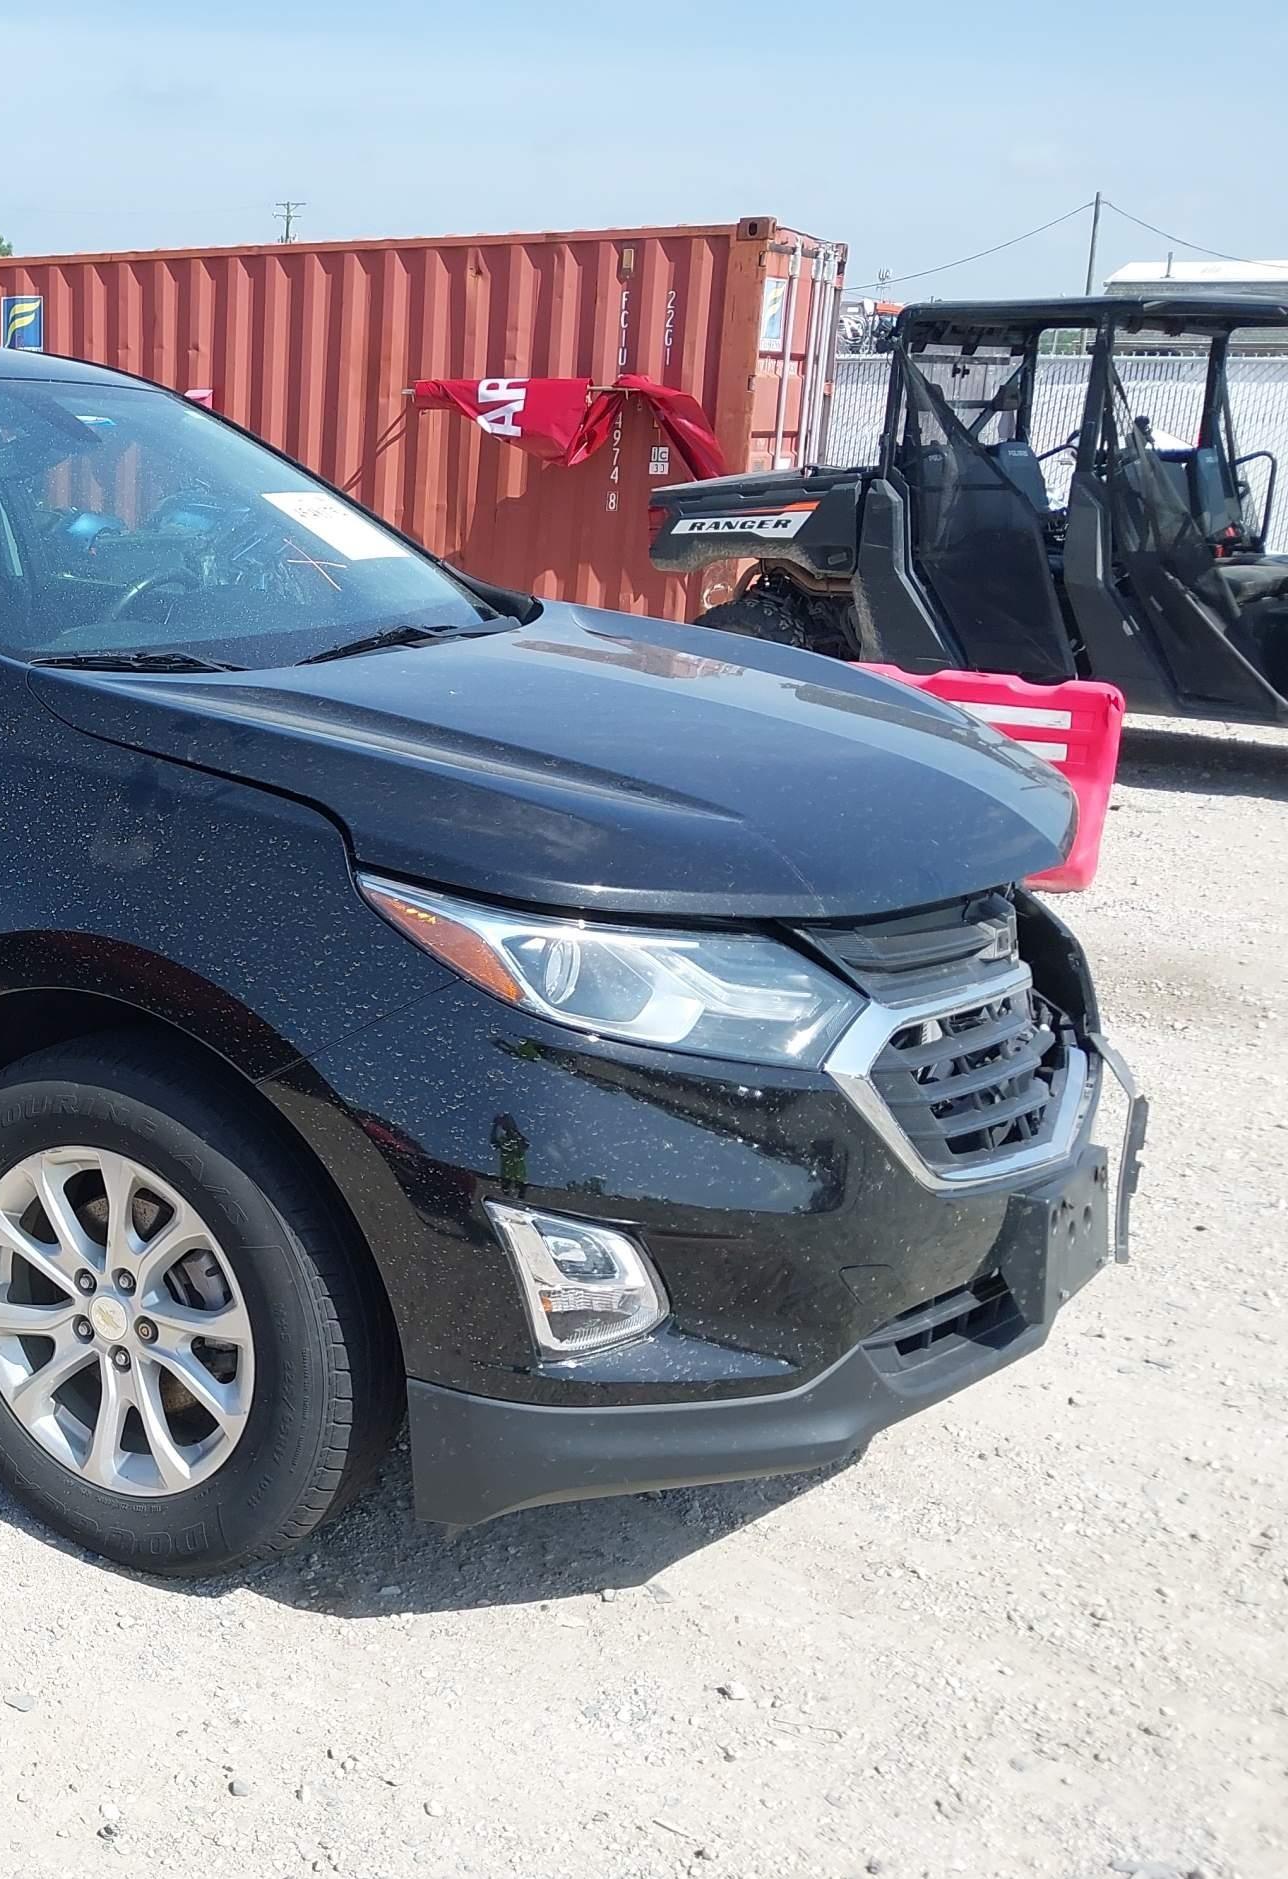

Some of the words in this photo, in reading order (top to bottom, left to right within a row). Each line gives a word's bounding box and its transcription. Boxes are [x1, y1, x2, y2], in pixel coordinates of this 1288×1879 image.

[618, 290, 630, 366] FCIU
[664, 290, 676, 366] 22G1
[610, 408, 623, 484] 4974
[607, 492, 617, 510] 8
[688, 519, 792, 532] RANGER
